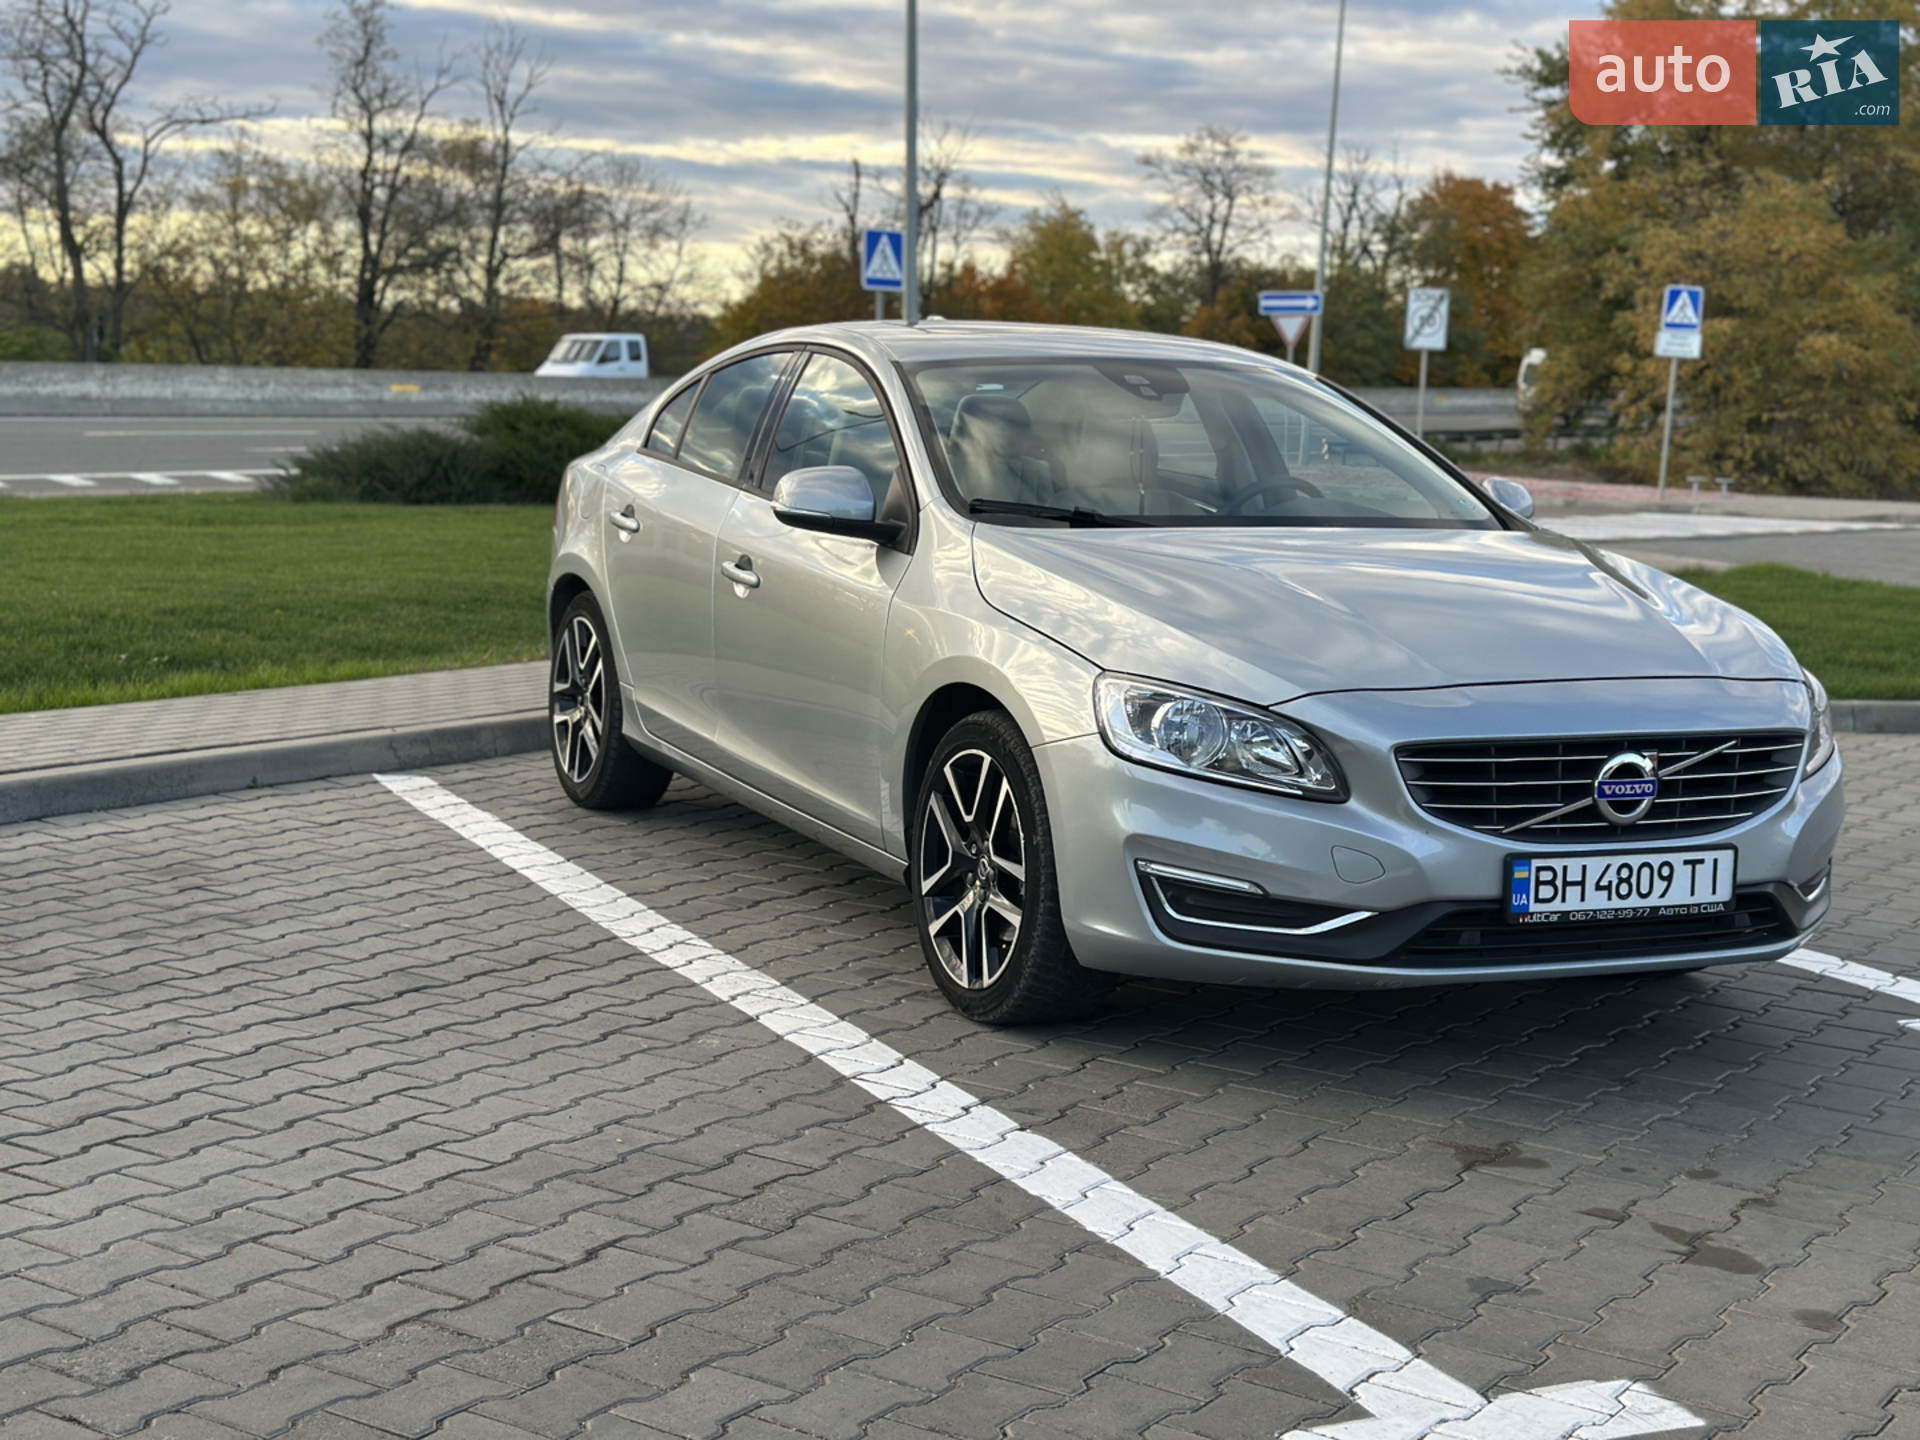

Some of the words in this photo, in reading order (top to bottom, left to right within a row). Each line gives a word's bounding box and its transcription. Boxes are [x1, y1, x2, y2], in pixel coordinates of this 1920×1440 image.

[1601, 783, 1653, 795] VOLVO
[1533, 864, 1587, 904] BH
[1594, 860, 1675, 901] 4809
[1683, 858, 1719, 897] TI
[1512, 893, 1528, 906] UA
[1700, 903, 1725, 913] США
